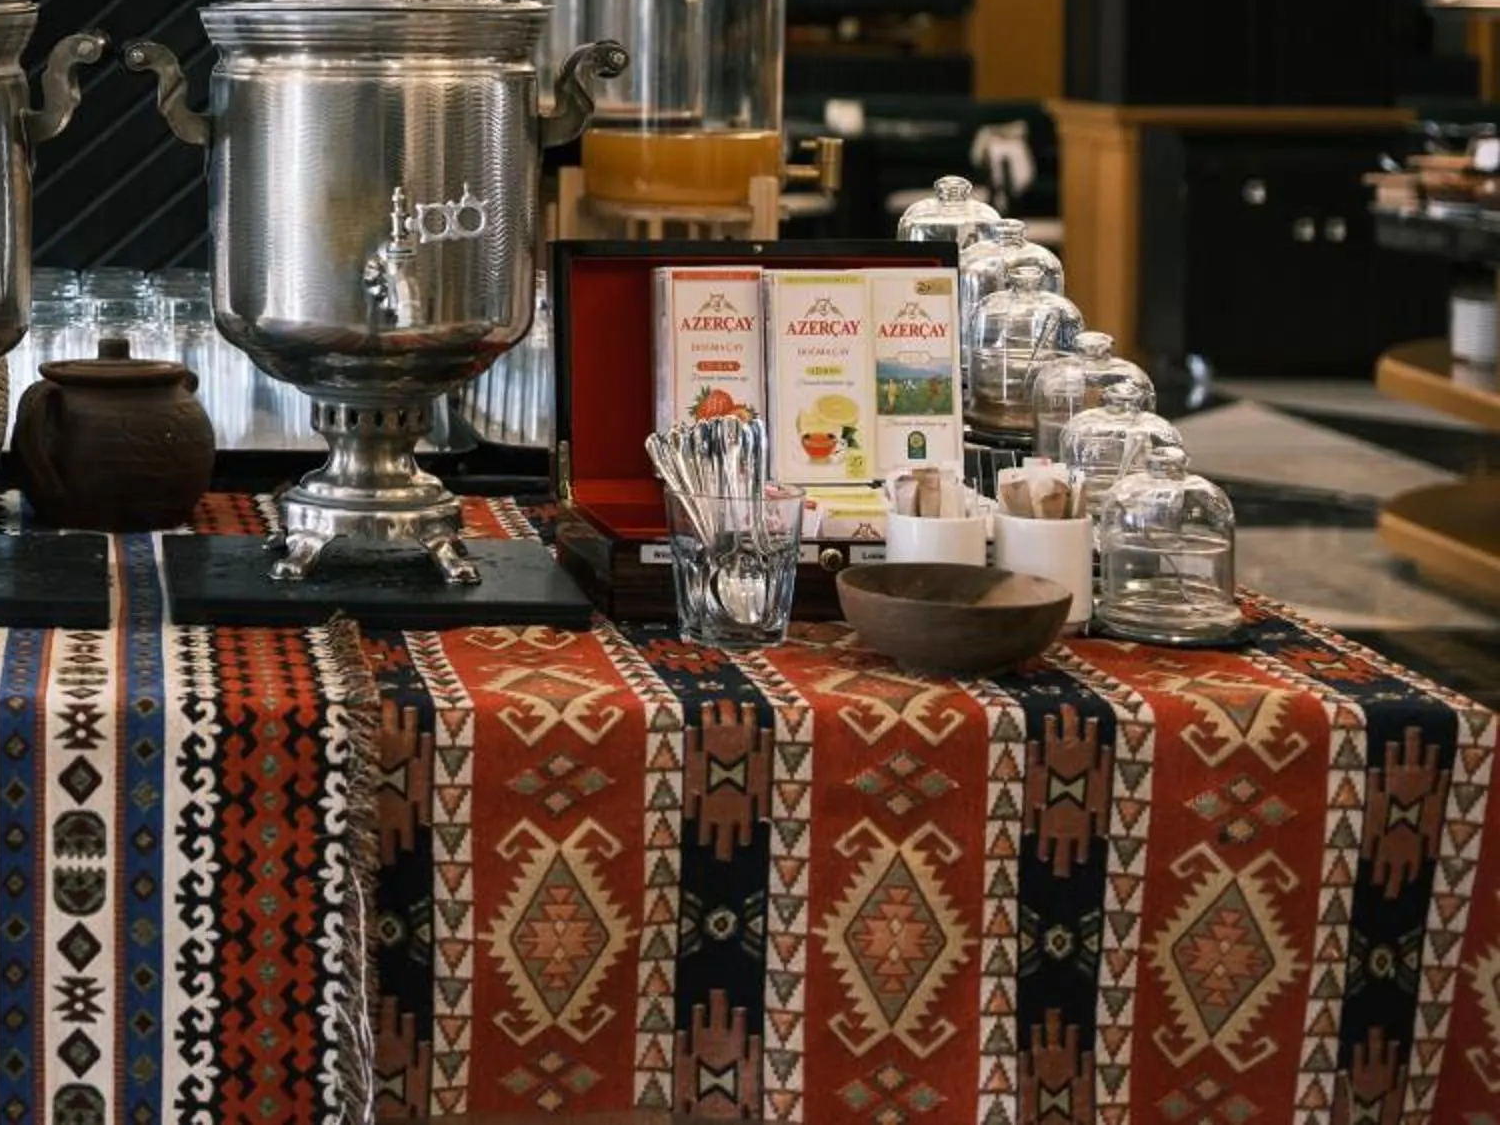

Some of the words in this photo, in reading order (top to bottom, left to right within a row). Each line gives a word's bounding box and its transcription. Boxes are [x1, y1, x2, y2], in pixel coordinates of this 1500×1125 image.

[680, 316, 755, 334] AZERÇAY
[786, 320, 861, 337] AZERÇAY
[878, 323, 949, 340] AZERÇAY
